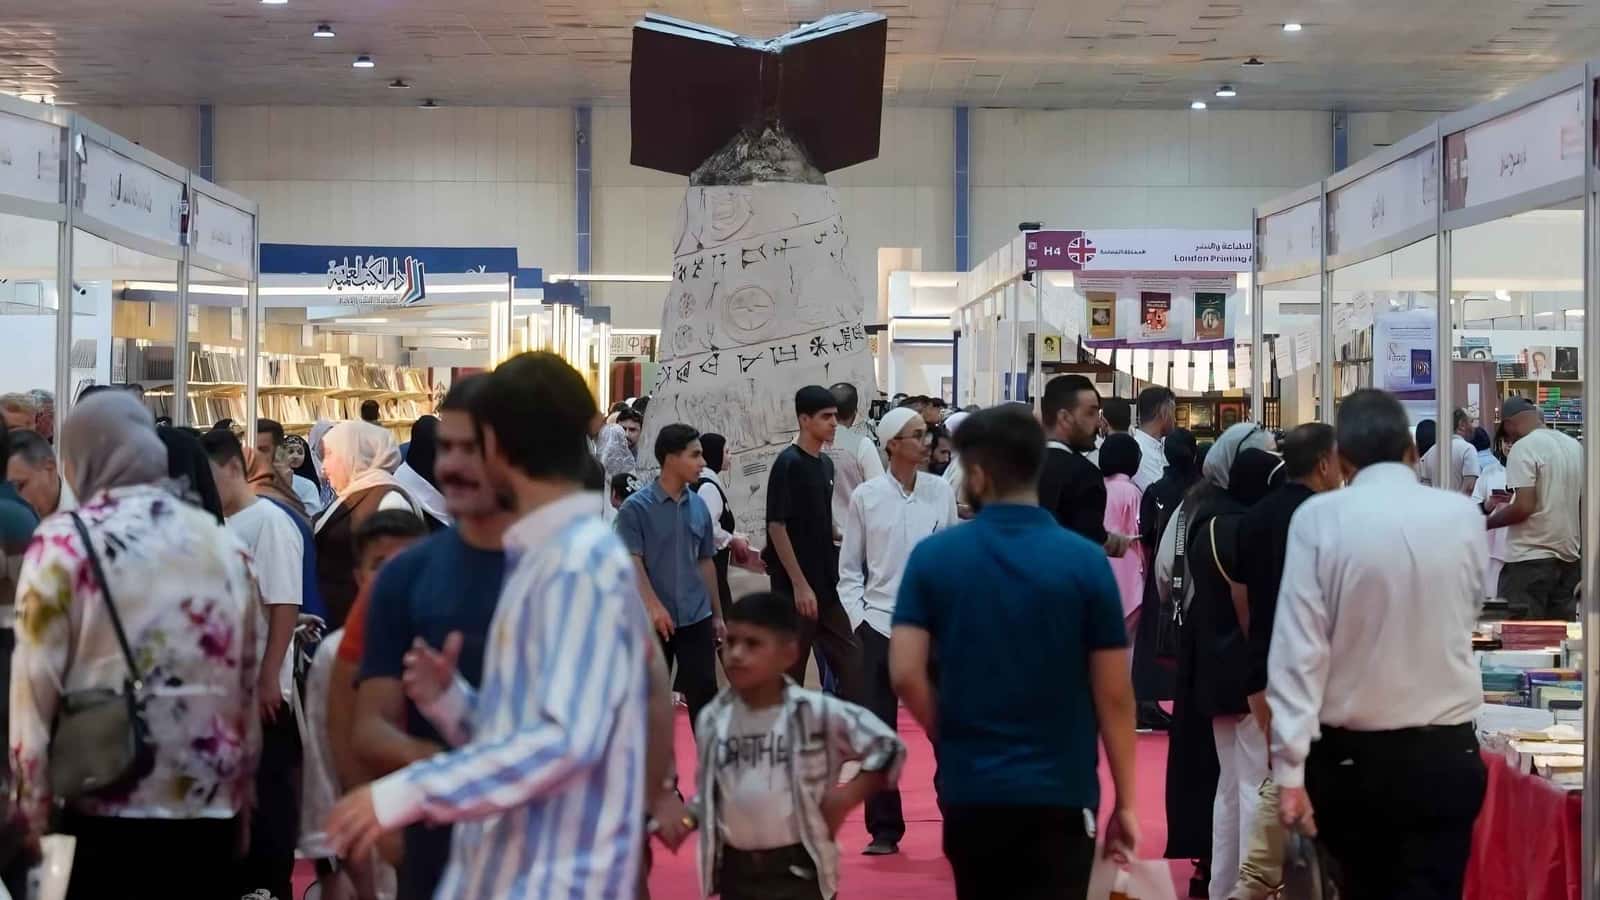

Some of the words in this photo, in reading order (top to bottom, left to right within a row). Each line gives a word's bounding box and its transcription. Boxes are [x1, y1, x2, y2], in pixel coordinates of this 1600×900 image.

[1044, 246, 1061, 256] H4
[1174, 254, 1209, 262] London
[1211, 254, 1247, 264] Printing
[383, 256, 405, 290] دار
